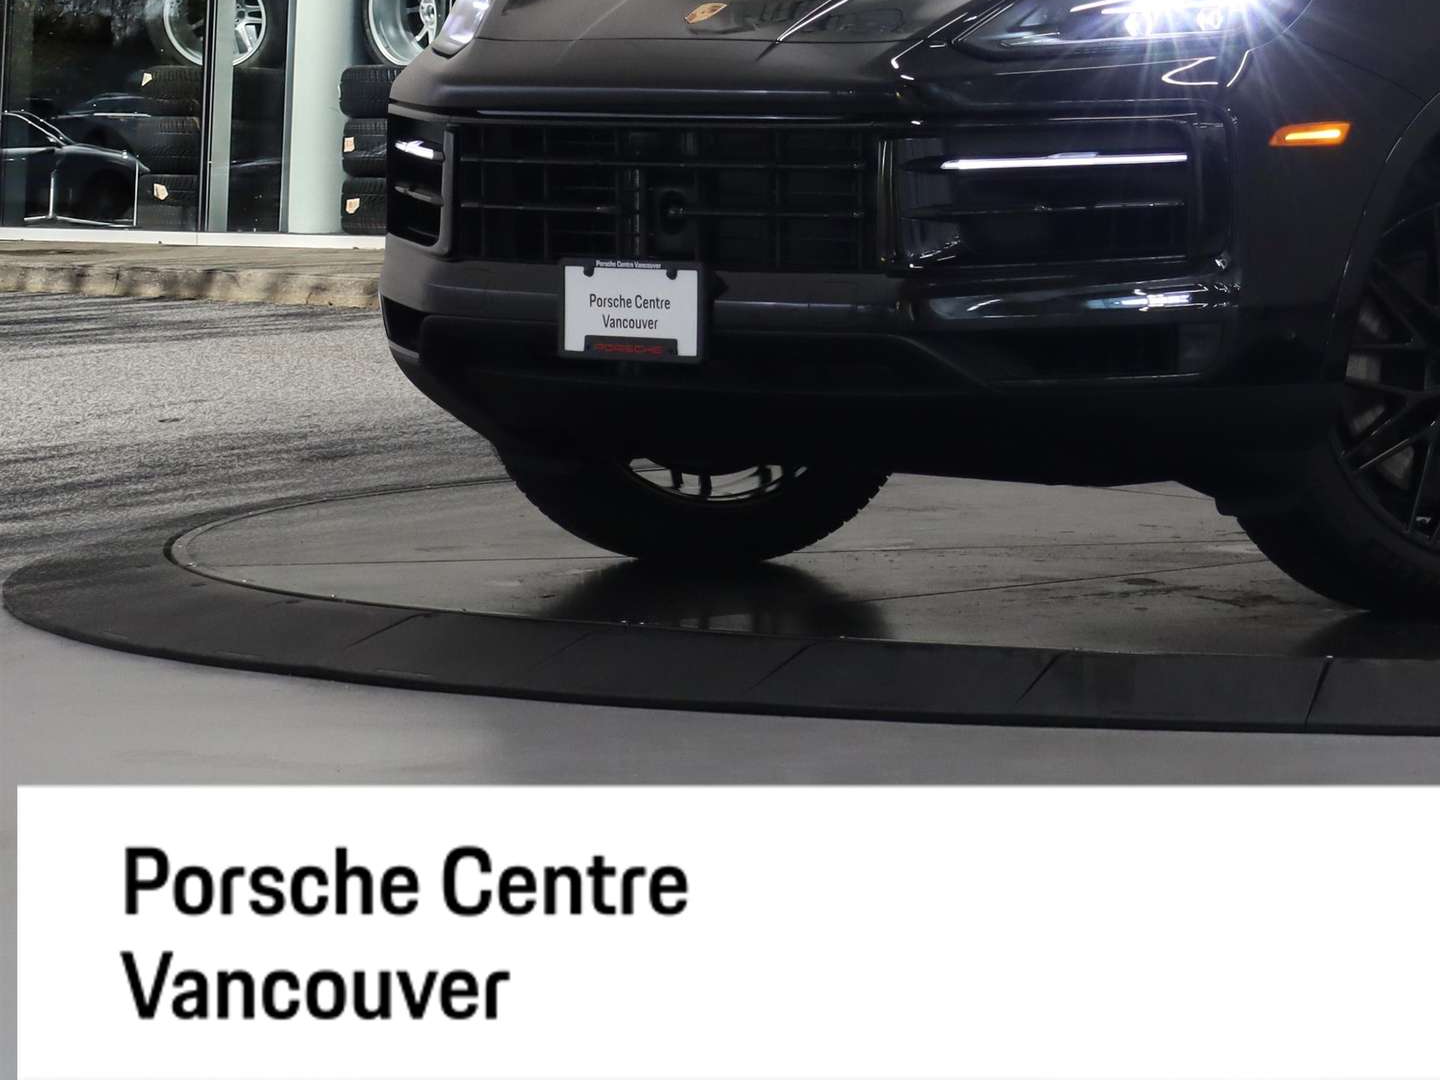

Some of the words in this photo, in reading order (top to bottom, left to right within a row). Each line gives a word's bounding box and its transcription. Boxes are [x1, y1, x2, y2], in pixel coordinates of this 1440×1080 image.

[589, 293, 632, 308] Porsche
[635, 295, 671, 309] Centre
[602, 314, 658, 329] Vancouver
